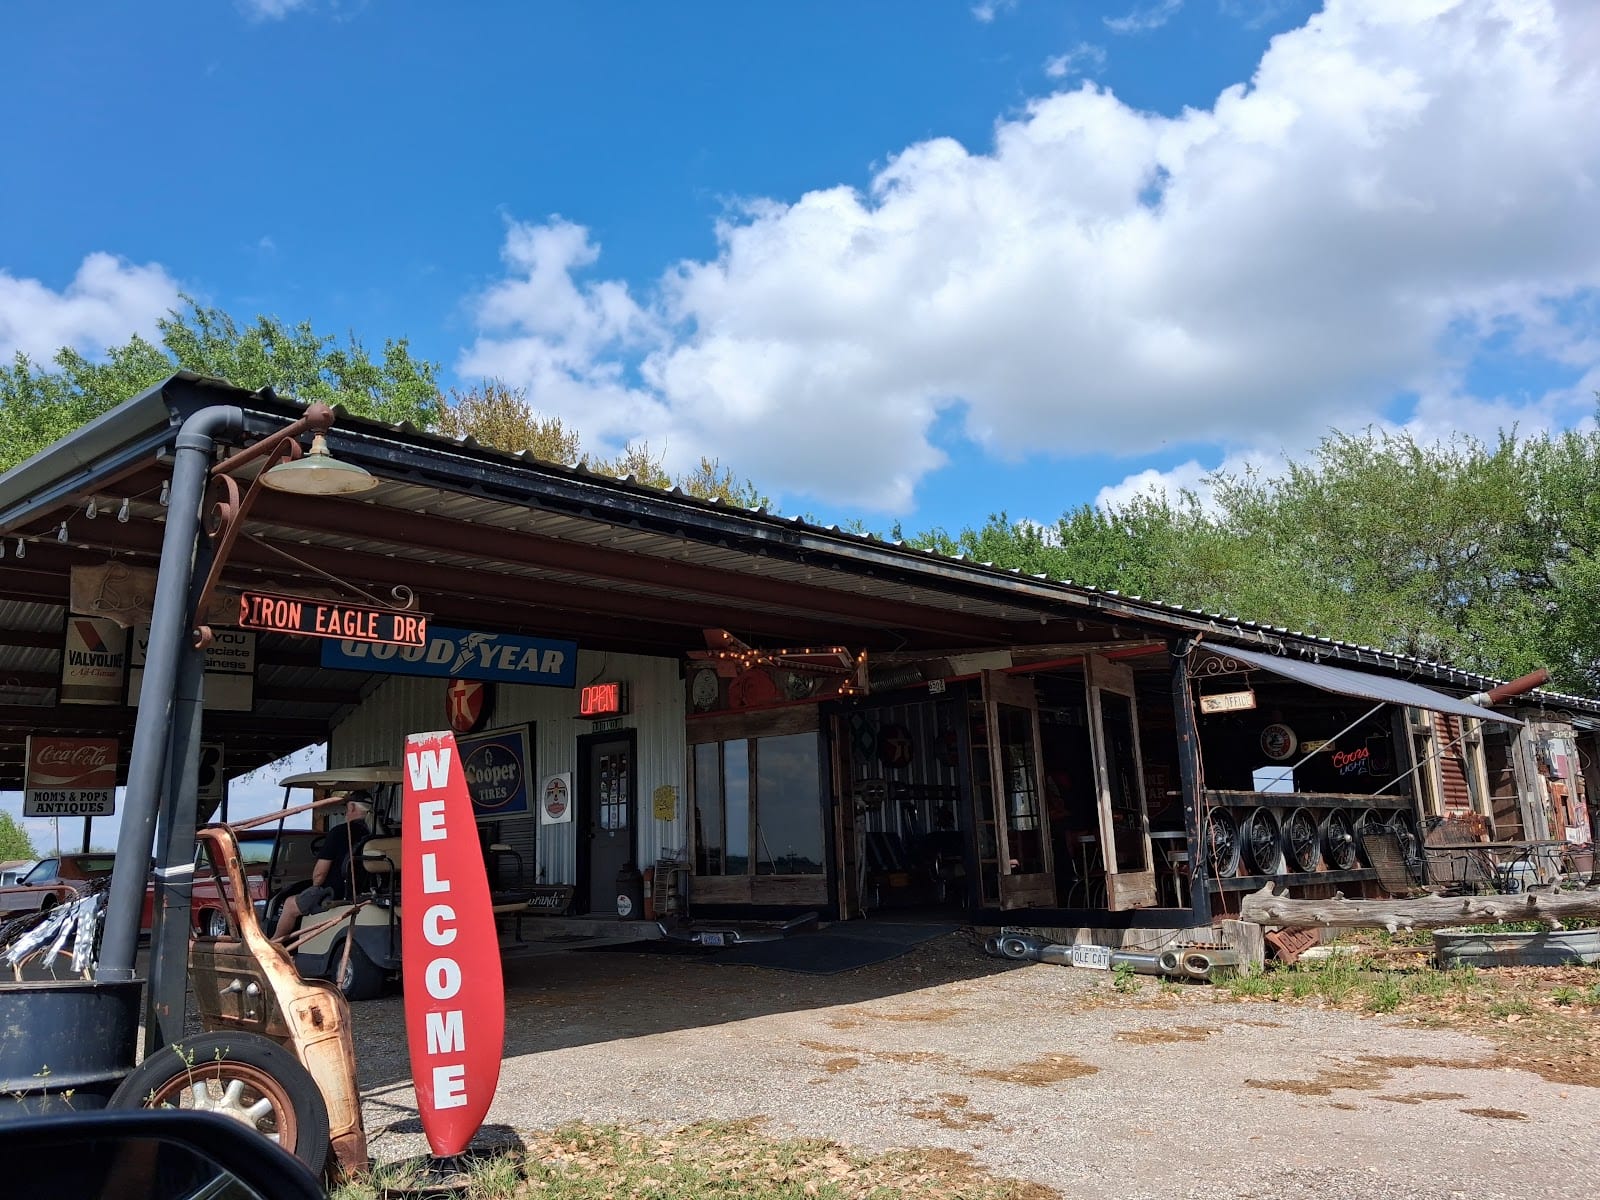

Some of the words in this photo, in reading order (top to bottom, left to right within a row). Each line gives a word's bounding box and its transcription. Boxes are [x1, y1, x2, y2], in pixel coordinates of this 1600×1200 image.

[250, 597, 302, 629] IRON
[315, 605, 380, 638] EAGLE
[393, 616, 417, 642] DR
[213, 634, 246, 644] YOU
[69, 650, 123, 668] VALVOLINE
[206, 647, 250, 657] eciate
[479, 642, 564, 674] YEAR
[204, 658, 246, 669] siness
[581, 684, 618, 713] OPEN
[36, 744, 110, 766] Coca-Cola
[1332, 748, 1370, 768] Coors
[465, 763, 516, 786] Cooper
[33, 792, 66, 802] MOM'S
[69, 792, 76, 801] &
[80, 792, 108, 802] POP'S
[479, 787, 507, 800] TIRES
[36, 802, 104, 814] ANTIQUES
[406, 748, 468, 1111] WELCOME
[1074, 951, 1089, 963] OLE
[1092, 953, 1107, 964] CAT
